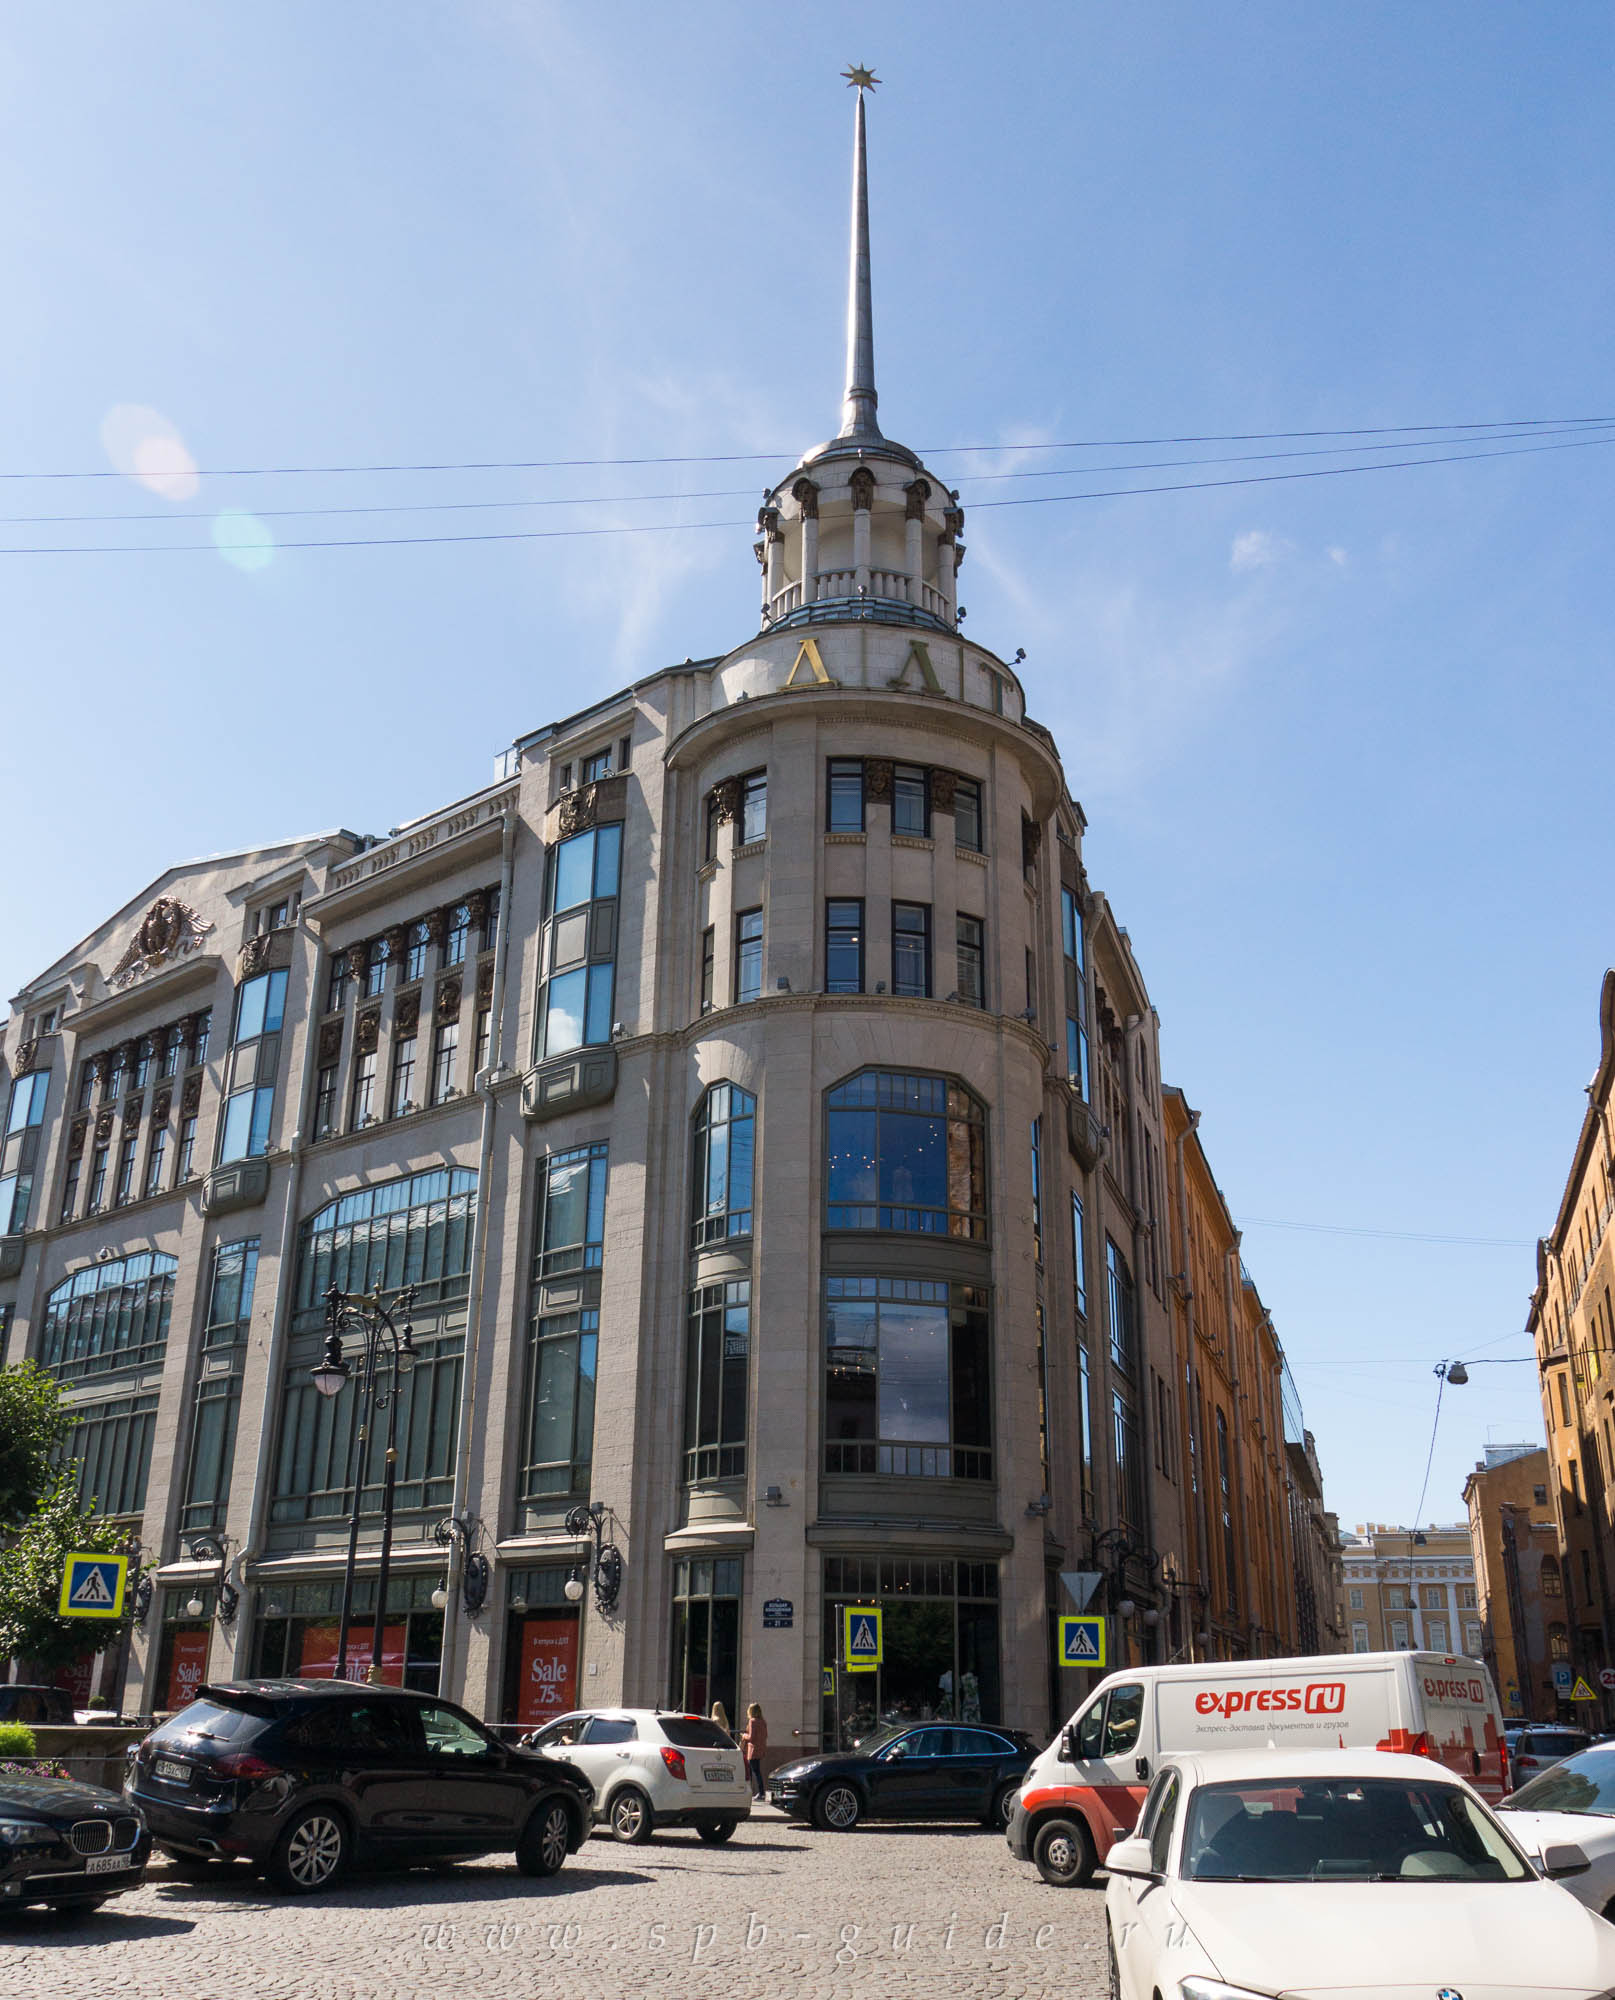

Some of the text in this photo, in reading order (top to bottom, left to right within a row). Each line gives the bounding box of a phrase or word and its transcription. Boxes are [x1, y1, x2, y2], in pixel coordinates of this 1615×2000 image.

[176, 1662, 201, 1683] Sale
[346, 1658, 367, 1683] ale
[531, 1657, 567, 1682] Sale
[1195, 1723, 1265, 1733] Экспресс-доставка
[1266, 1721, 1314, 1732] документов
[1323, 1721, 1349, 1730] грузов
